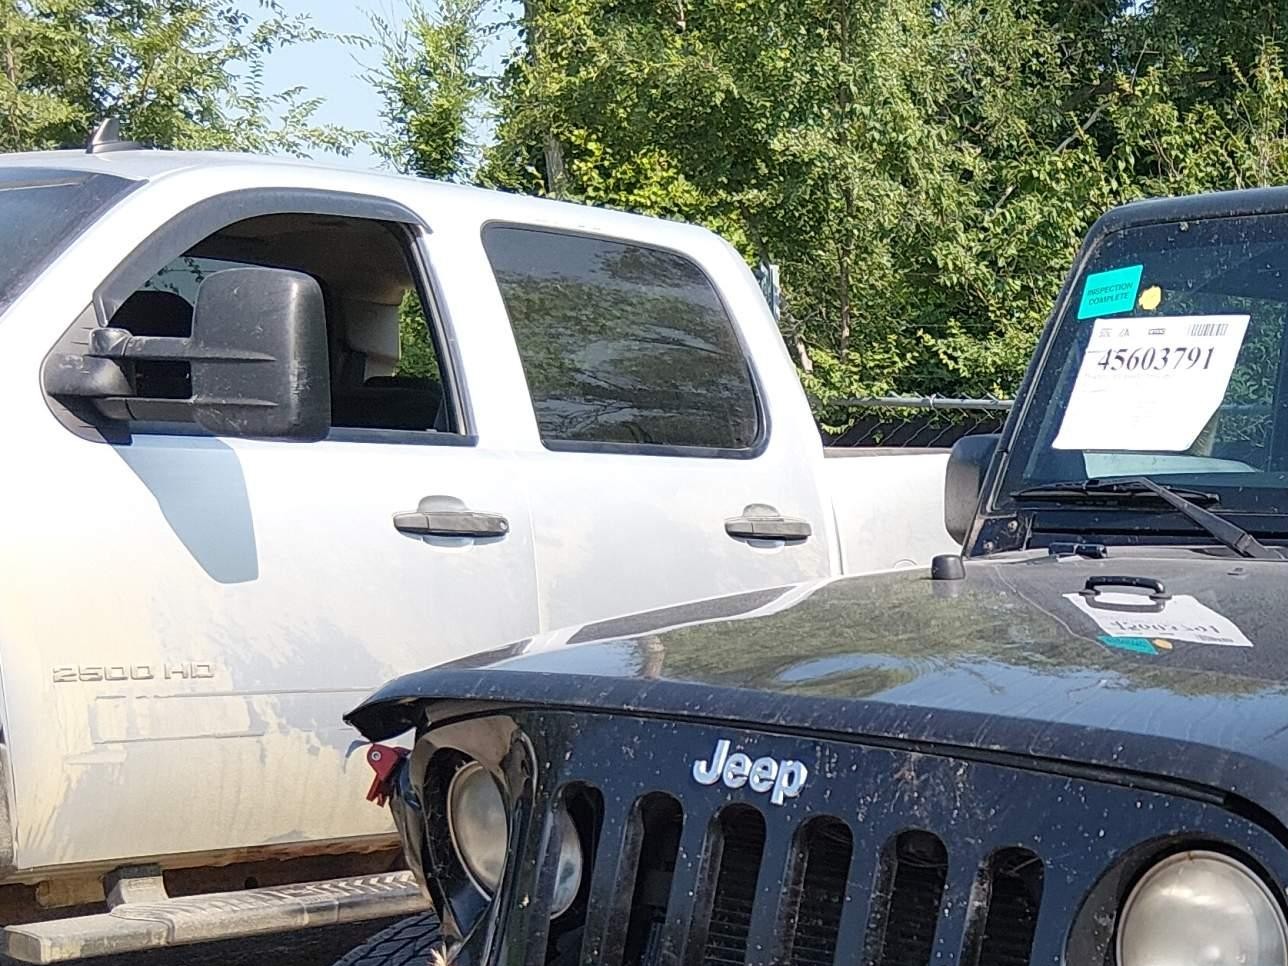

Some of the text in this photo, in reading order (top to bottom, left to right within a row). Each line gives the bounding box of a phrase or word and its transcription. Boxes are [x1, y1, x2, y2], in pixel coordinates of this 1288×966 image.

[1087, 281, 1134, 296] INSPECTION
[1088, 293, 1129, 305] COMPLETE
[1097, 346, 1215, 371] 45603791
[52, 662, 215, 683] 2500 HD
[692, 739, 808, 805] Jeep
